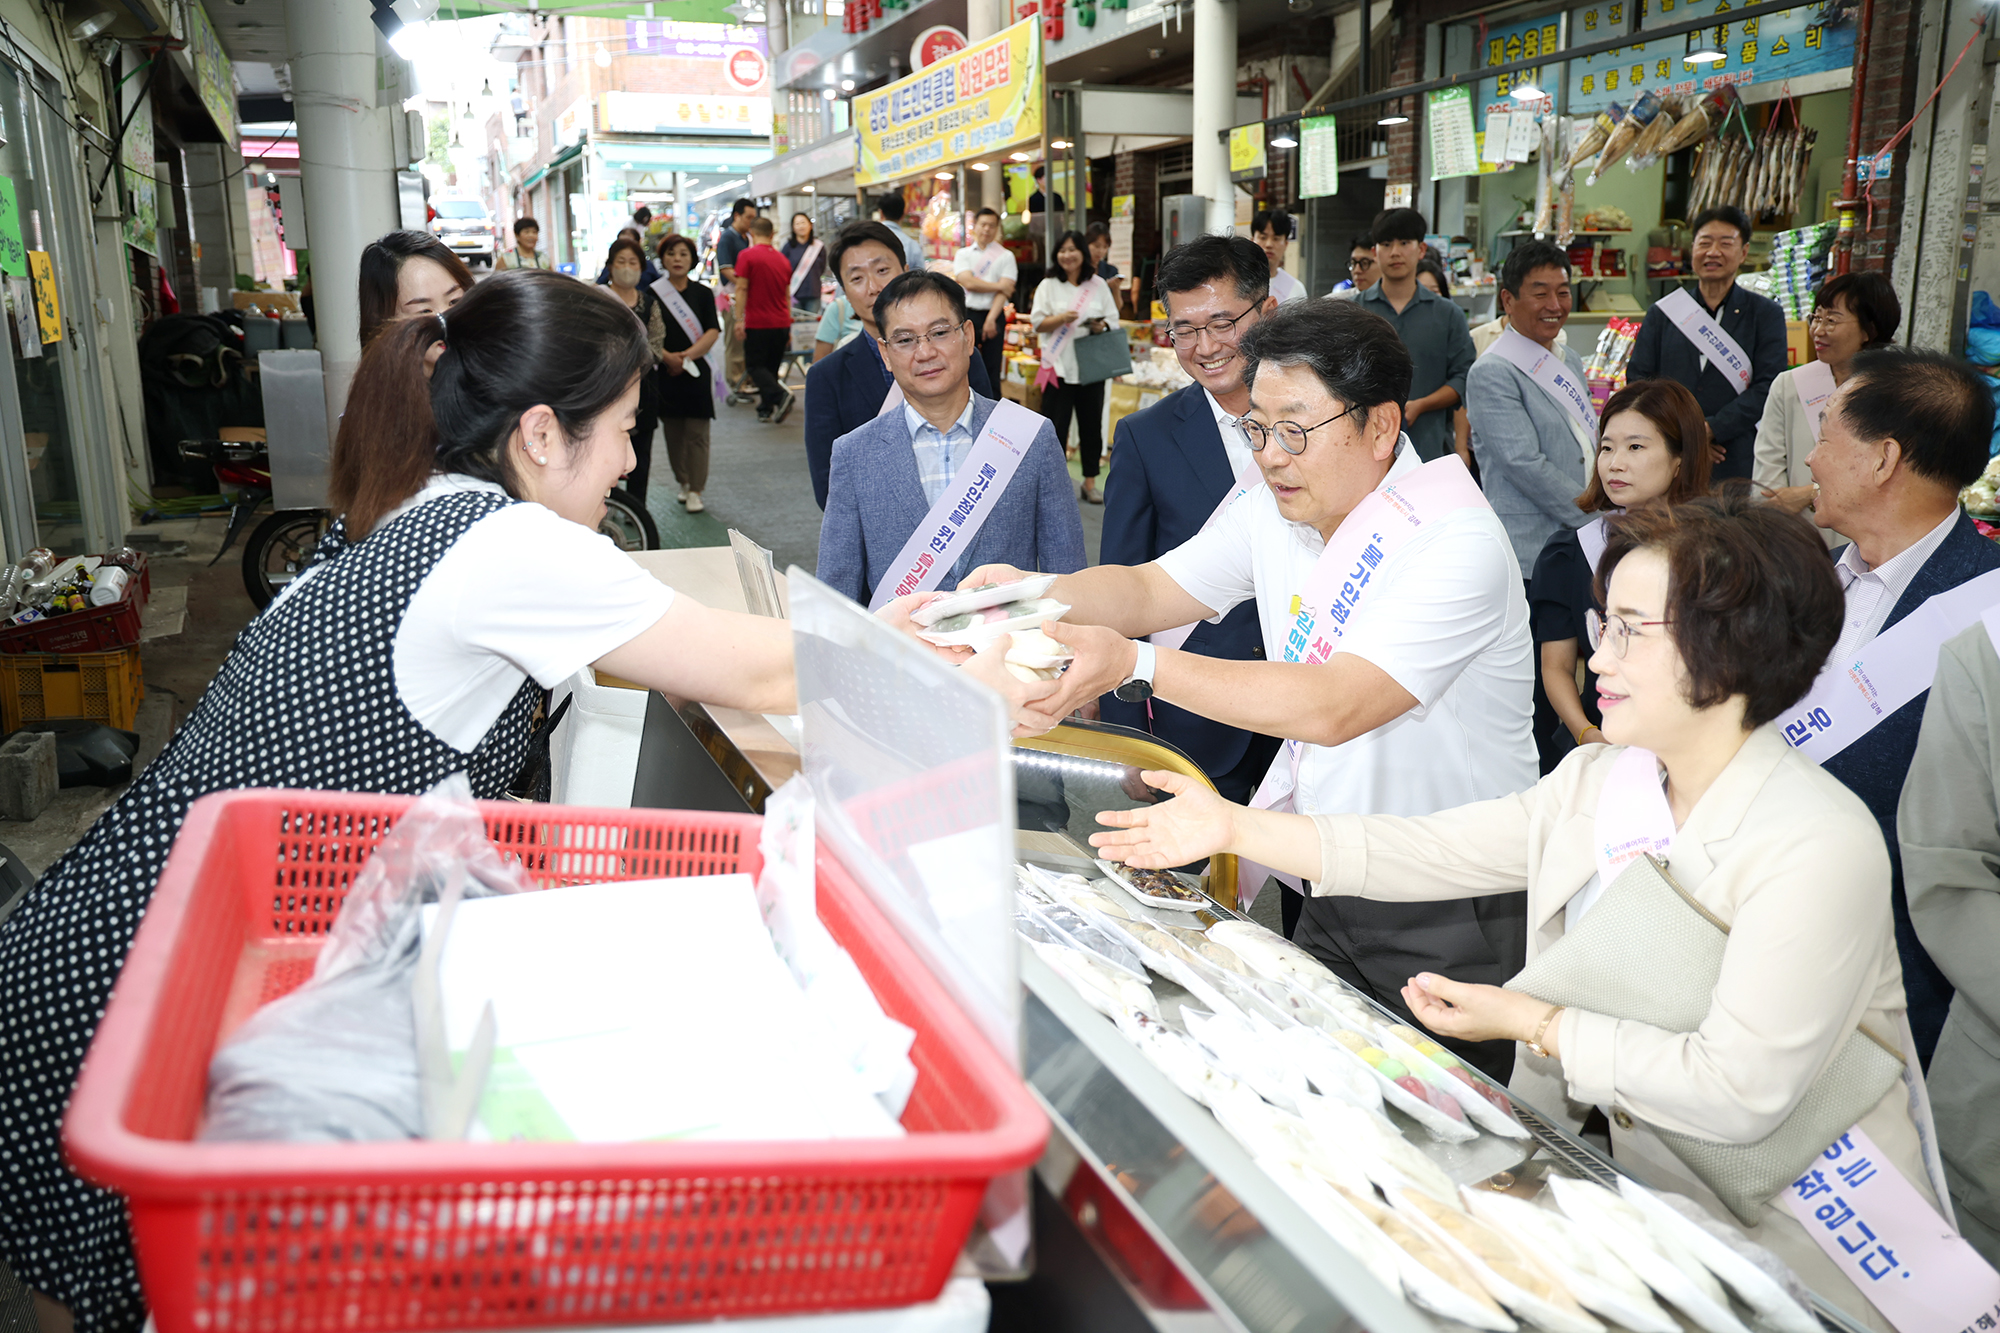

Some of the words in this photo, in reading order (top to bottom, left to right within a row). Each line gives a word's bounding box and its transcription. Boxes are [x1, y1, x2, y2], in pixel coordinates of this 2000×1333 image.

[1487, 24, 1558, 67] 제수용품
[869, 94, 890, 134] 삼방
[891, 63, 957, 126] 배드민턴클럽
[958, 38, 1012, 100] 회원모집
[947, 462, 998, 529] 물가안정을
[928, 524, 956, 555] 위한
[894, 552, 936, 597] 슬기로운
[1870, 700, 1883, 716] 김해
[1619, 836, 1651, 851] 이루어지는
[1653, 836, 1671, 851] 김해
